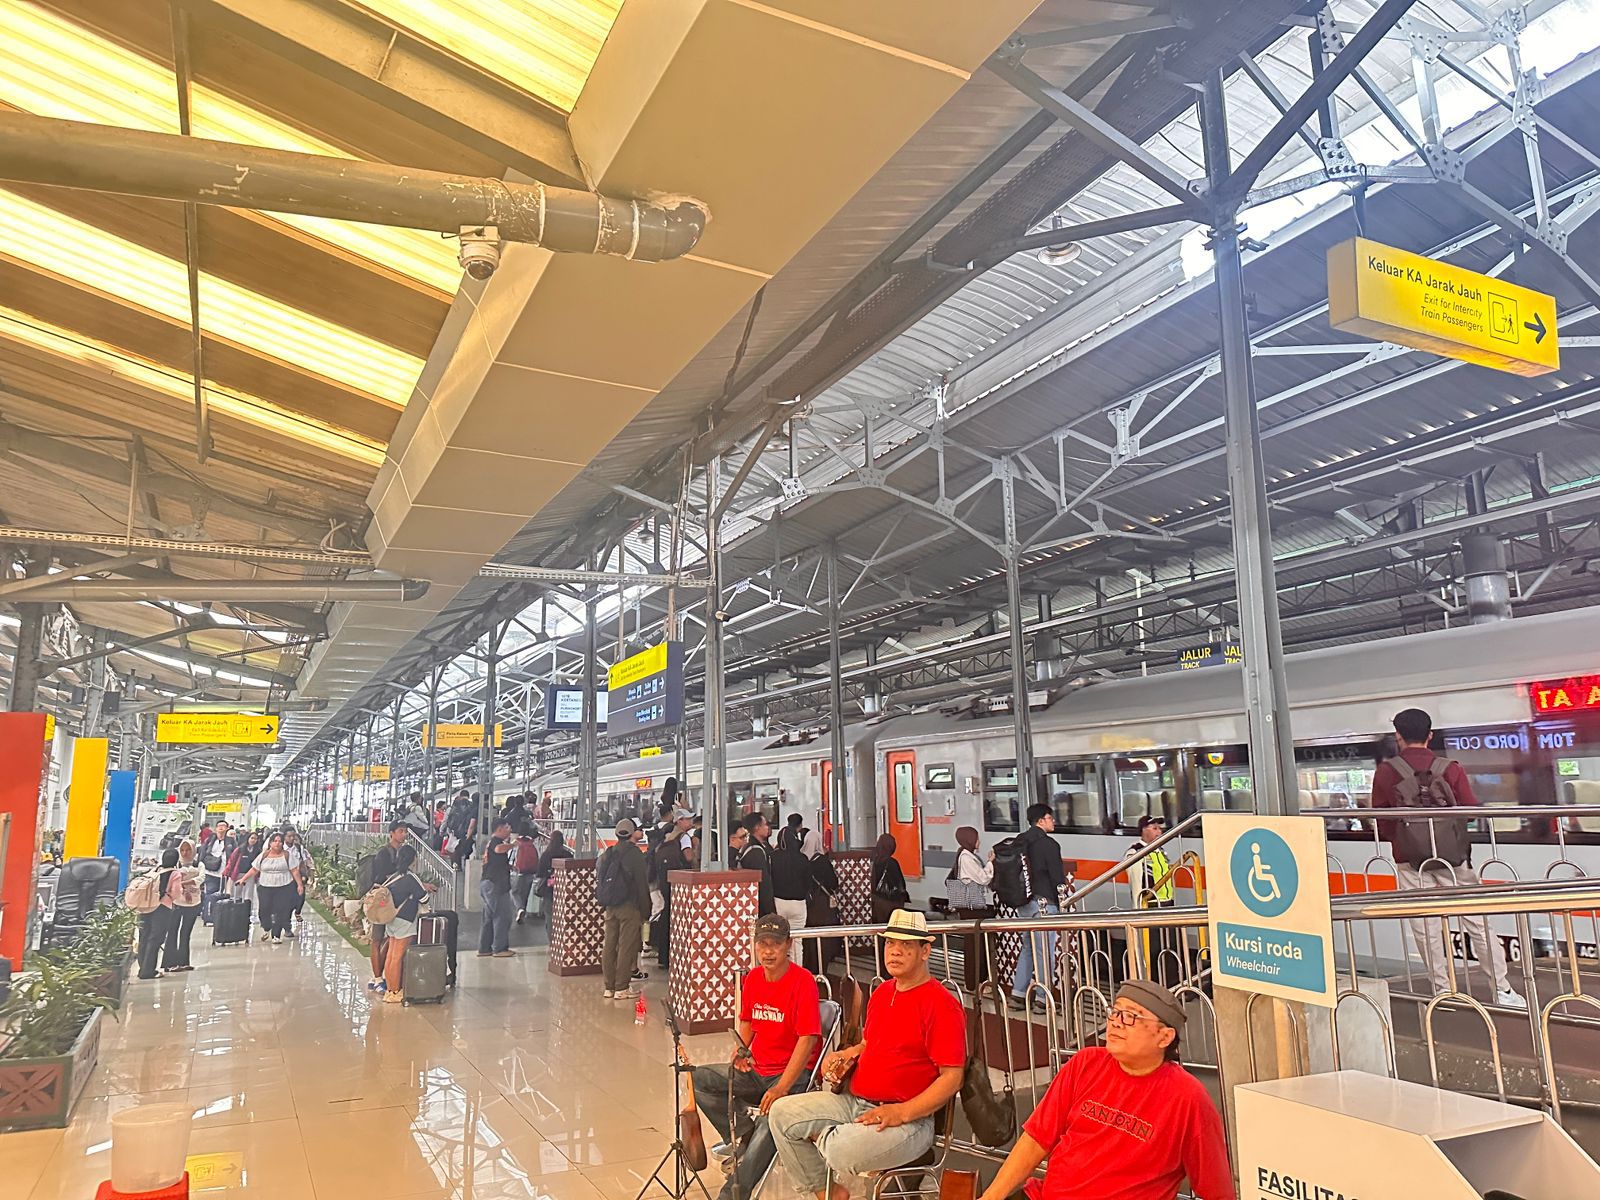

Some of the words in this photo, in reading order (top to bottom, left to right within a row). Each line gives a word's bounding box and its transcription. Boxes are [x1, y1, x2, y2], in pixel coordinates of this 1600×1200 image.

[1368, 255, 1404, 279] Keluar
[1406, 267, 1423, 285] KA
[1425, 274, 1455, 295] Jarak
[1457, 283, 1482, 302] Jauh
[1424, 293, 1439, 306] Exit
[1440, 297, 1451, 309] for
[1452, 300, 1483, 319] Intercity
[1420, 306, 1440, 320] Train
[1442, 311, 1484, 333] Passengers
[1180, 647, 1212, 662] JALUR
[1223, 645, 1242, 657] JAL
[1224, 657, 1241, 665] TRAC
[1180, 661, 1200, 670] TRACK
[1225, 931, 1262, 954] Kursi
[1266, 941, 1303, 961] roda
[1226, 955, 1281, 976] Wheelchair
[1258, 1167, 1357, 1200] FASILIT
